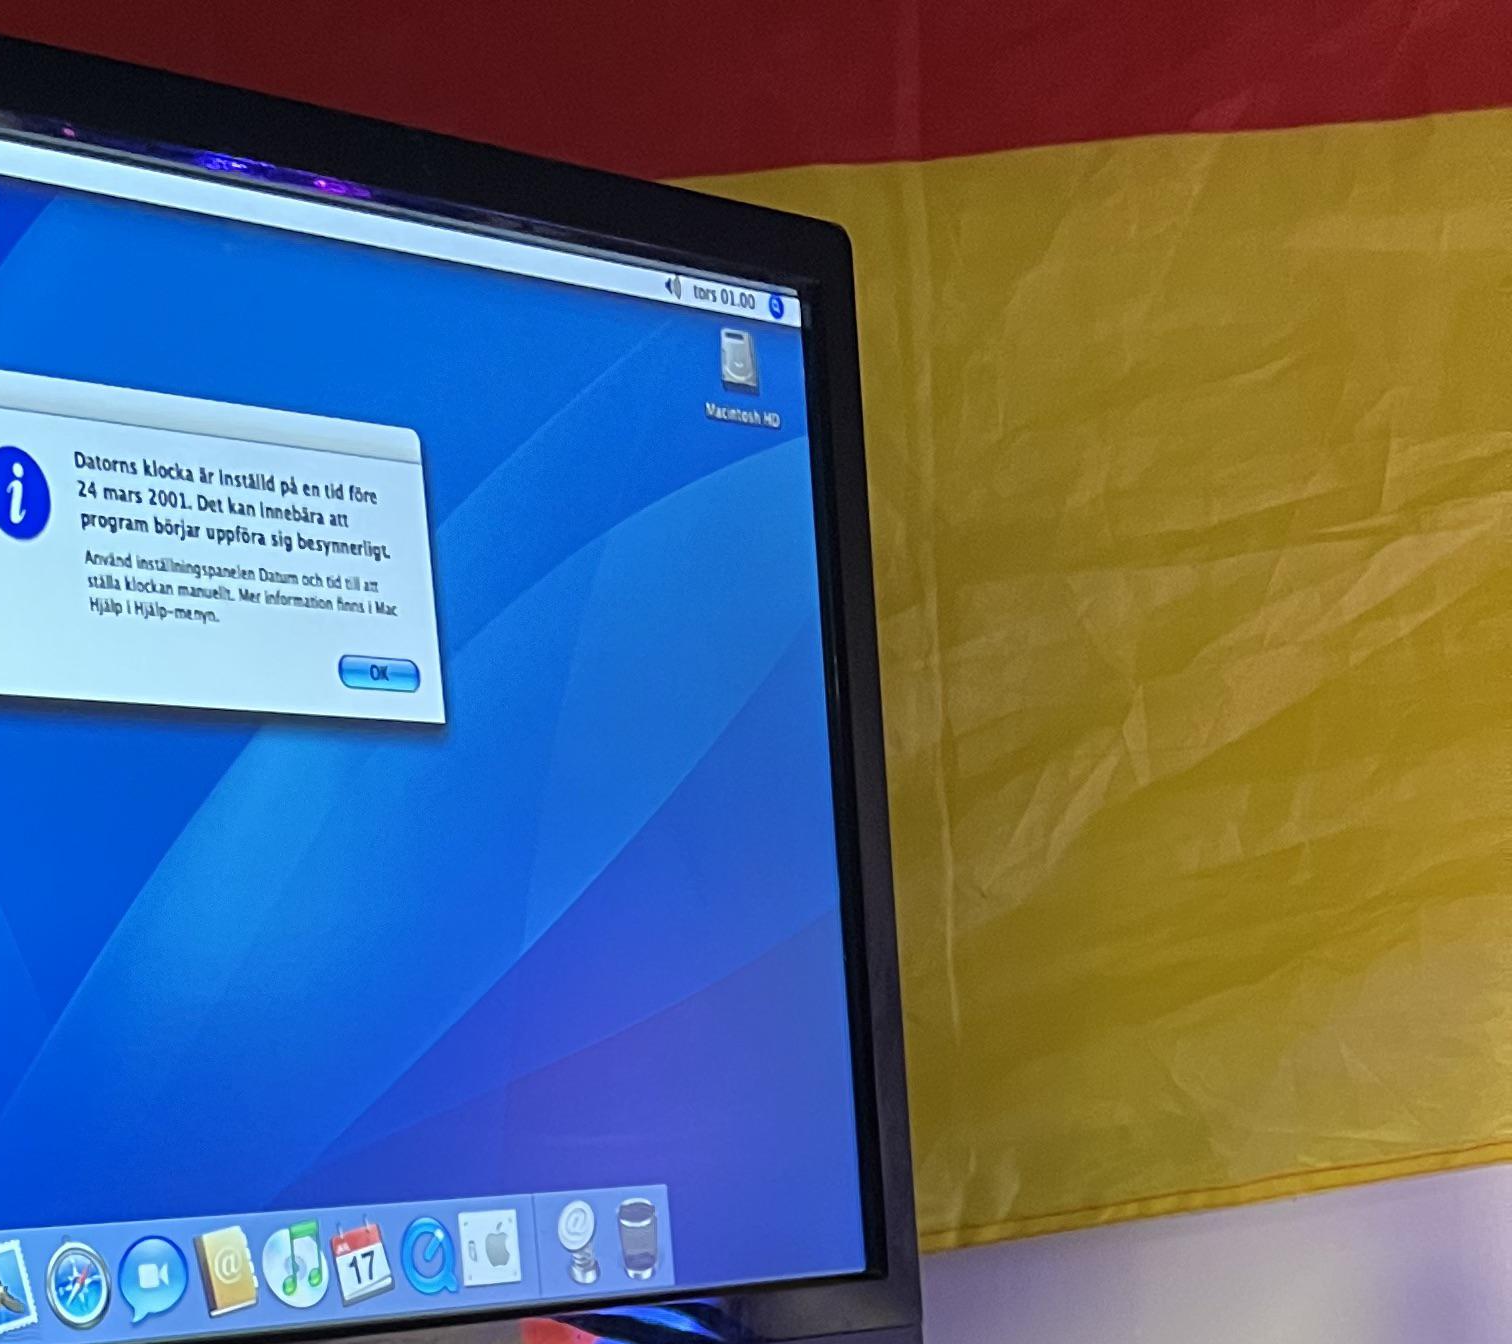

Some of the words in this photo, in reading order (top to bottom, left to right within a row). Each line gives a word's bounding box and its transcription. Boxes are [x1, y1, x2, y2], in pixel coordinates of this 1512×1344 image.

[694, 285, 717, 302] tors
[720, 288, 755, 309] 01.00
[705, 402, 761, 425] Macintosh
[763, 412, 781, 428] HD
[75, 451, 137, 475] Datorns
[143, 459, 193, 483] klocka
[200, 465, 214, 485] är
[219, 468, 275, 492] inställd
[280, 477, 298, 497] på
[303, 482, 320, 498] en
[324, 482, 344, 501] tid
[349, 486, 377, 504] före
[77, 480, 97, 499] 24
[103, 486, 143, 504] mars
[149, 488, 192, 510] 2001.
[197, 495, 223, 513] Det
[227, 497, 255, 517] kan
[260, 502, 324, 526] innebära
[329, 512, 348, 528] att
[81, 512, 149, 535] program
[154, 517, 201, 541] börjar
[206, 525, 265, 547] uppföra
[271, 532, 292, 552] sig
[297, 532, 391, 561] besynnerligt.
[85, 550, 132, 568] Använd
[259, 567, 298, 585] Datum
[302, 572, 323, 587] och
[326, 574, 342, 589] tid
[88, 575, 120, 590] ställa
[124, 575, 174, 595] klockan
[239, 588, 261, 604] Mer
[265, 589, 333, 610] information
[375, 601, 398, 617] Mac
[89, 596, 122, 616] Hjälp
[369, 664, 390, 682] OK
[349, 1250, 374, 1284] 17
